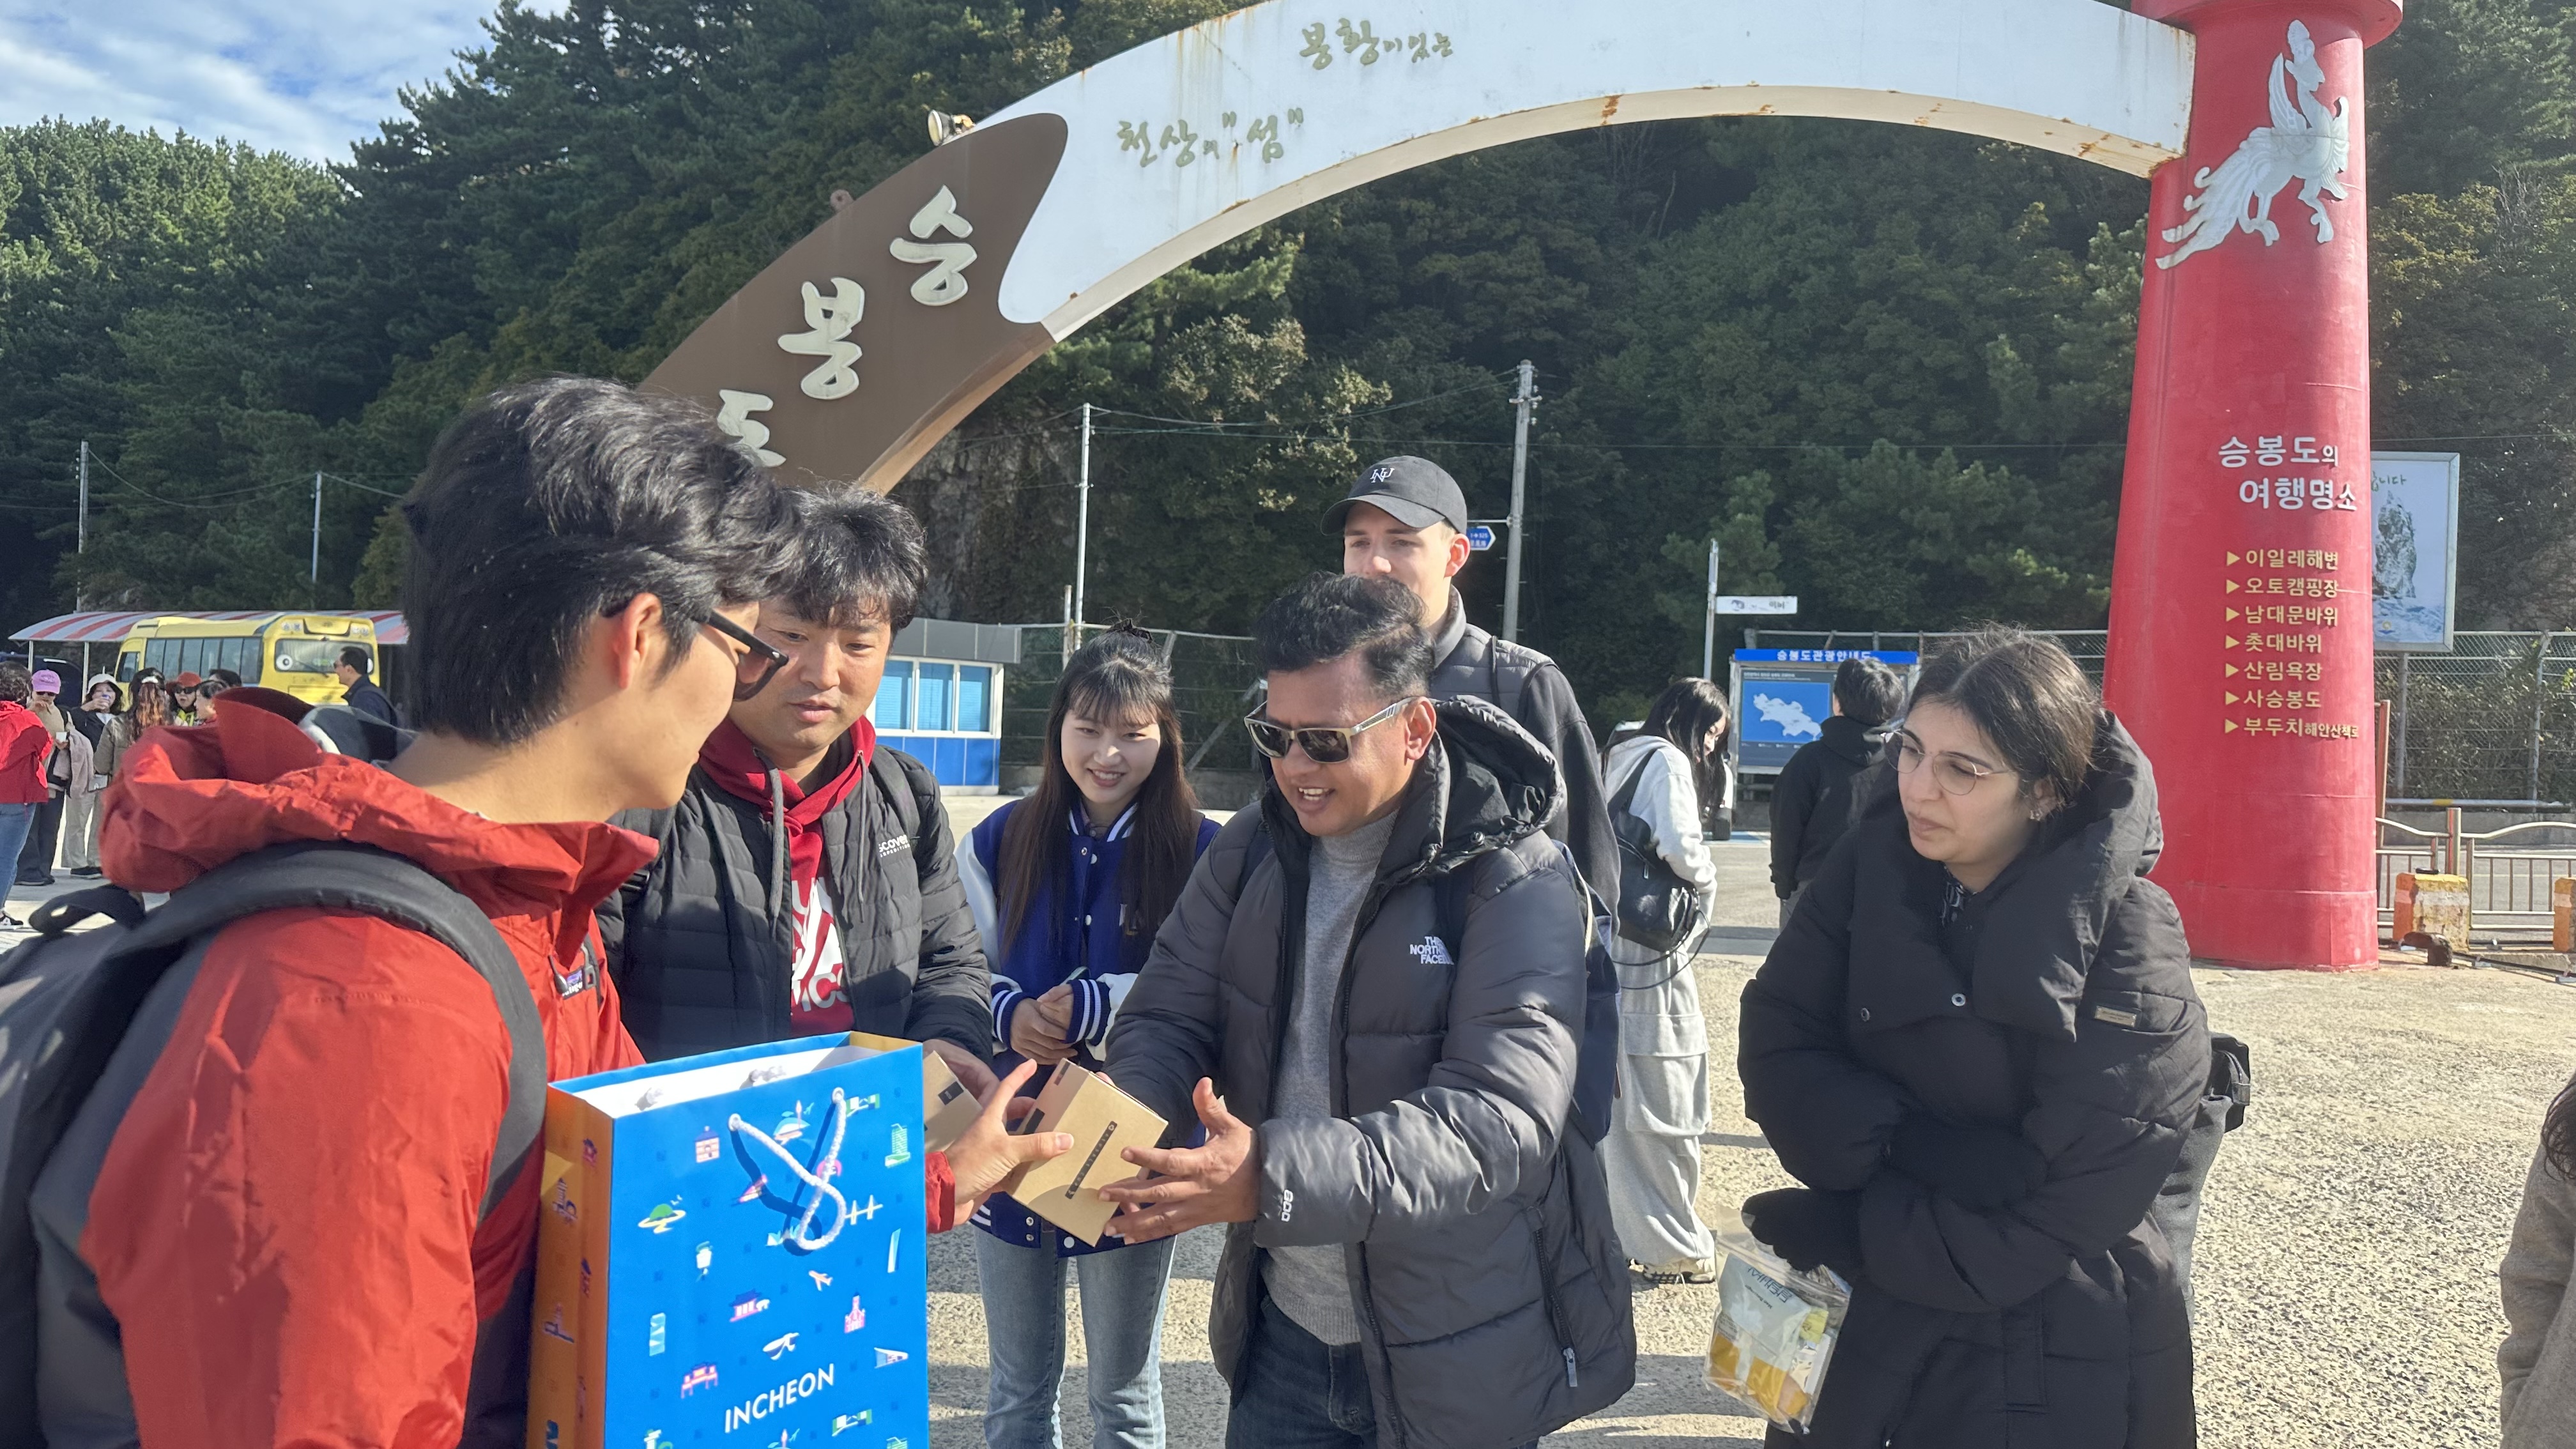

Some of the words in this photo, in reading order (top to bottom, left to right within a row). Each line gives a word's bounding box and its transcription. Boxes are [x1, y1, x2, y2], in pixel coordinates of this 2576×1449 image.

[716, 184, 978, 468] 승봉도
[2218, 435, 2338, 468] 승봉도의
[2239, 477, 2357, 511] 여행명소
[2245, 548, 2338, 571] 이일레해변
[2244, 577, 2339, 599] 오토캠핑장
[2244, 604, 2338, 627] 남대문바위
[2244, 632, 2322, 654] 촛대바위
[2243, 661, 2323, 681] 산림욕장
[2243, 689, 2322, 709] 사승봉도
[1420, 954, 1446, 964] FACE
[723, 1362, 834, 1433] INCHEON
